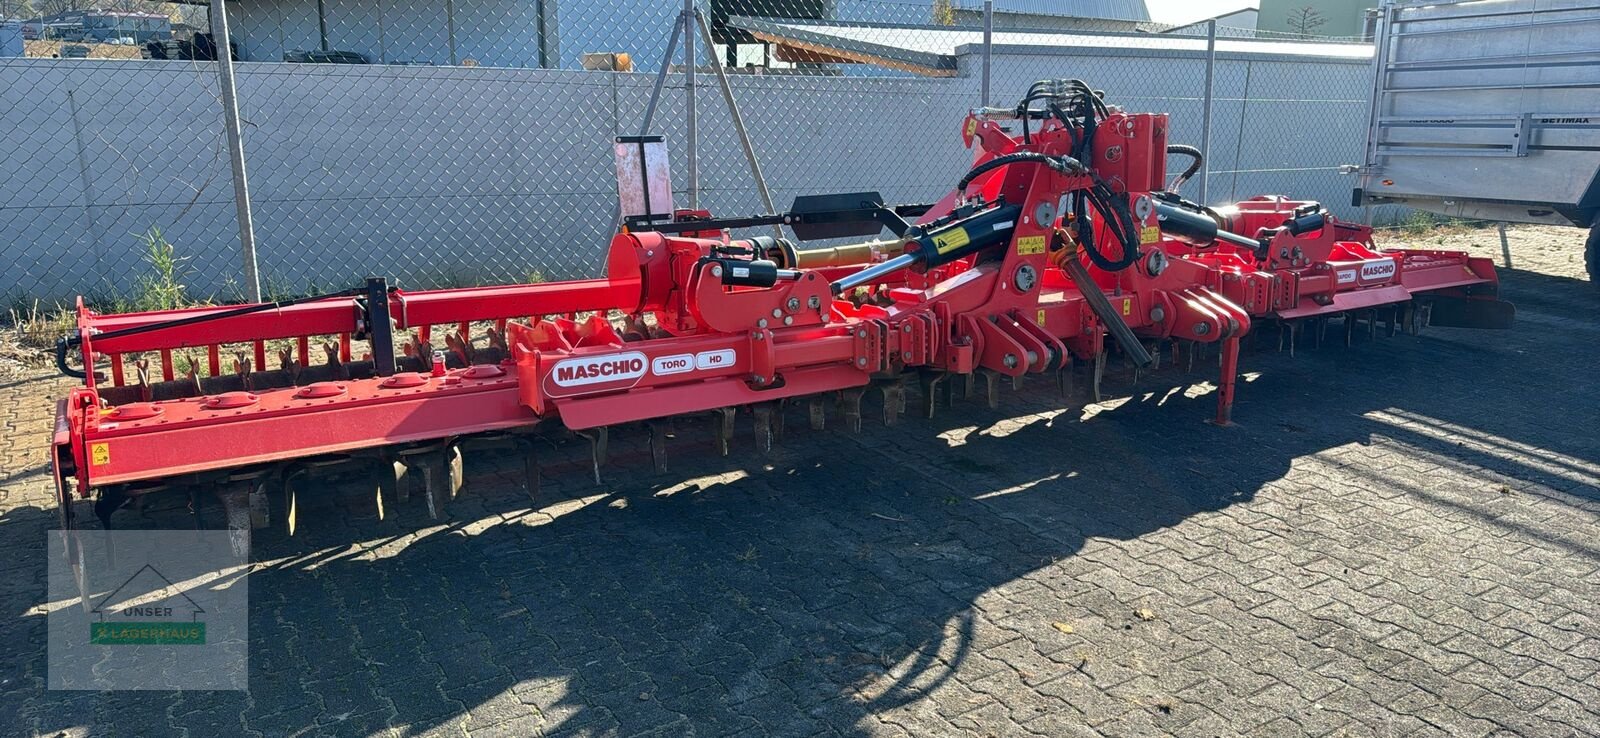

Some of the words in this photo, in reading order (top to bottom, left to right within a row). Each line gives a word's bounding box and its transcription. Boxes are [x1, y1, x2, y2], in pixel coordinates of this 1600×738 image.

[1362, 264, 1394, 277] MASCHIO
[557, 358, 643, 382] MASCHIO
[661, 359, 687, 370] TORO
[709, 355, 722, 364] HD
